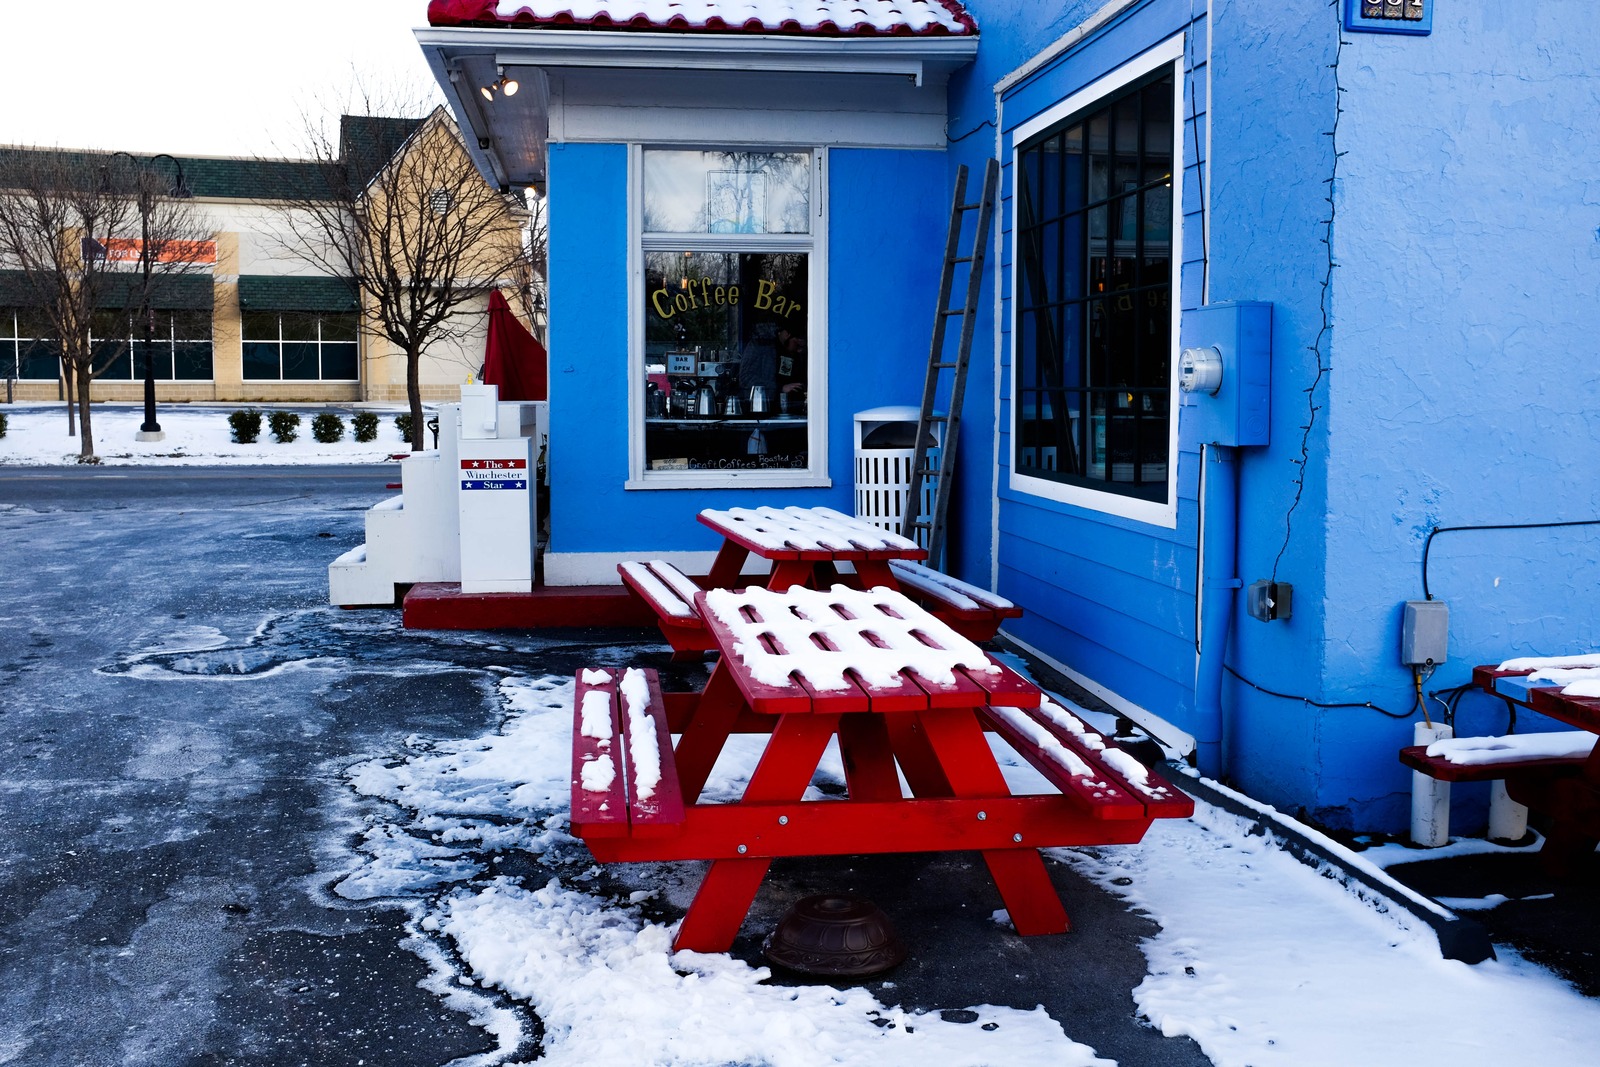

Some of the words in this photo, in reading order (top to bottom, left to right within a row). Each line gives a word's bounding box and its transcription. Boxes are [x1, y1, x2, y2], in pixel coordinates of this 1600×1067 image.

[109, 249, 128, 258] FOR
[652, 276, 739, 319] Coffee
[754, 279, 801, 318] Bar
[758, 454, 789, 463] Roasted
[483, 460, 503, 469] The
[718, 458, 756, 469] Coffees
[466, 470, 522, 479] Winchester
[483, 480, 504, 489] Star
